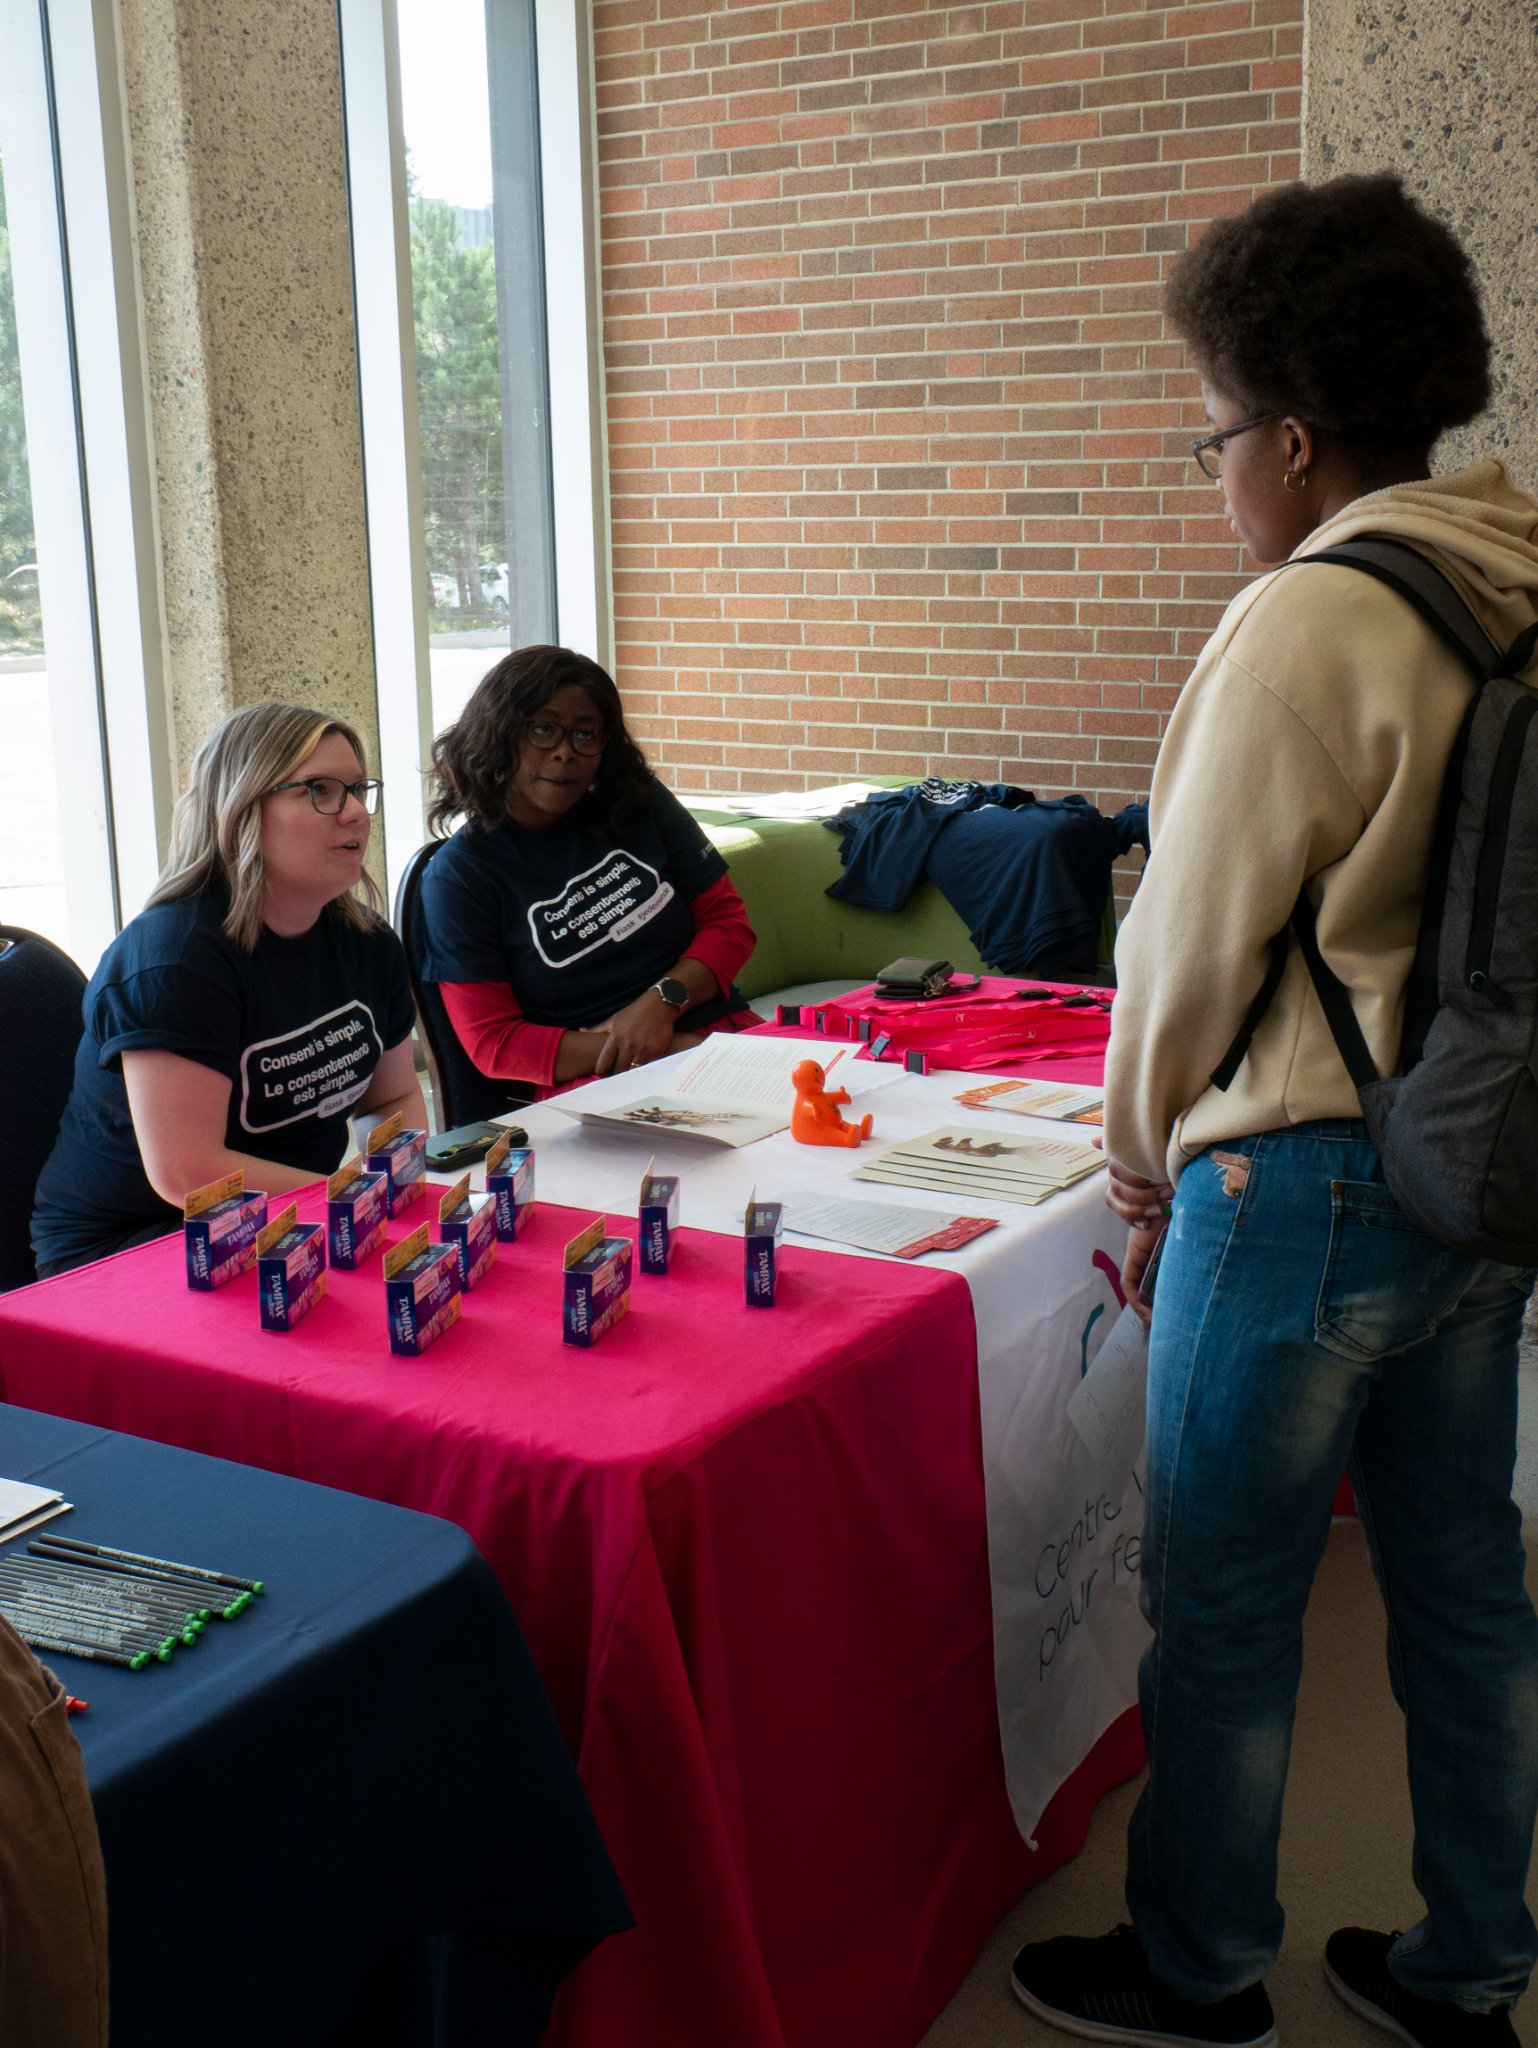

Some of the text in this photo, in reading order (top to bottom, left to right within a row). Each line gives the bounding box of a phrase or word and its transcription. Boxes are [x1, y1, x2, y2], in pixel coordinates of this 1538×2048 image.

[544, 861, 631, 923] Consent is simple.
[550, 876, 642, 940] Le consentement
[578, 897, 637, 939] est simple.
[260, 1020, 364, 1073] Consent is simple.
[264, 1042, 370, 1098] Le consentement
[293, 1069, 358, 1105] est simple.
[195, 1236, 208, 1280] TAMPAX
[339, 1216, 352, 1258] TAMPAX
[653, 1219, 664, 1263] TAMPAX
[271, 1272, 286, 1319] TAMPAX
[759, 1250, 771, 1296] TAMPAX
[399, 1296, 414, 1344] TAMPAX
[576, 1287, 588, 1335] TAMPAX
[1035, 1492, 1122, 1598] Centre
[1040, 1569, 1098, 1682] pour
